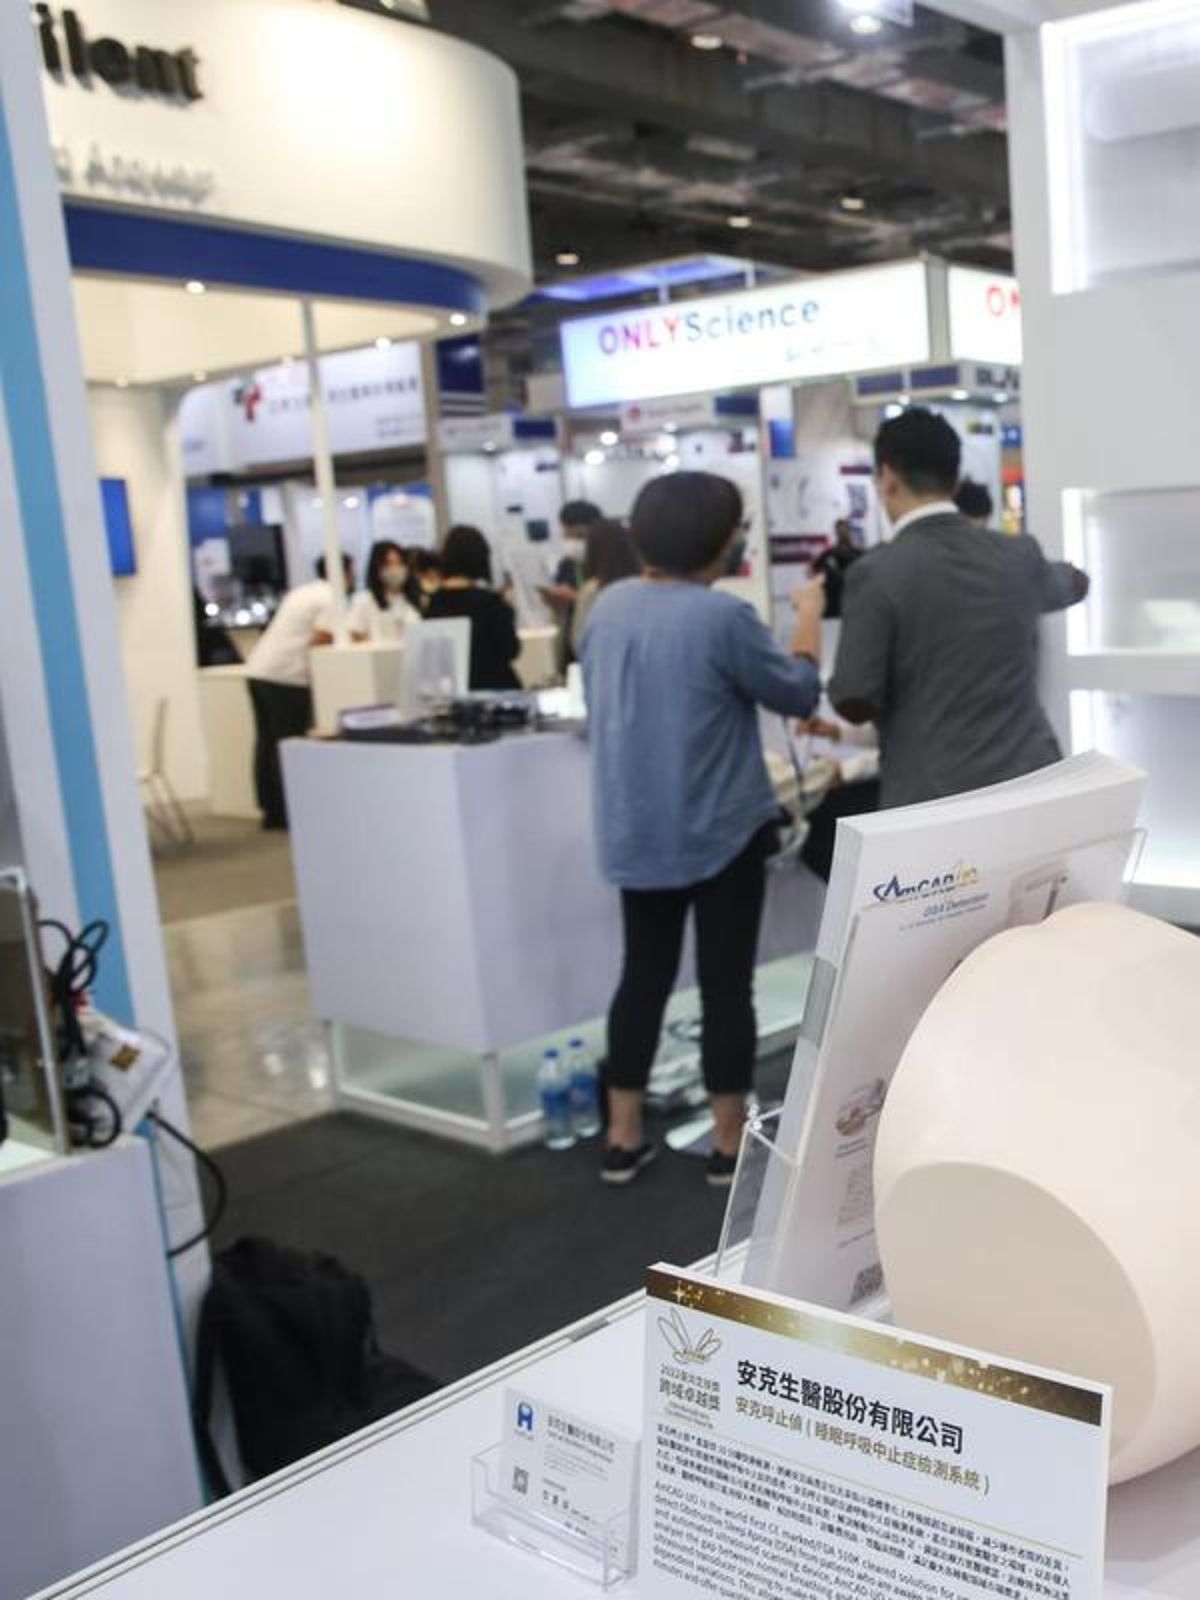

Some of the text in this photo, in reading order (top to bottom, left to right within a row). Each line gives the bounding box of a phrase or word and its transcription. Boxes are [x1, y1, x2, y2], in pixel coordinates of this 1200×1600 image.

[737, 1360, 963, 1454] 安克生醫股份有限公司
